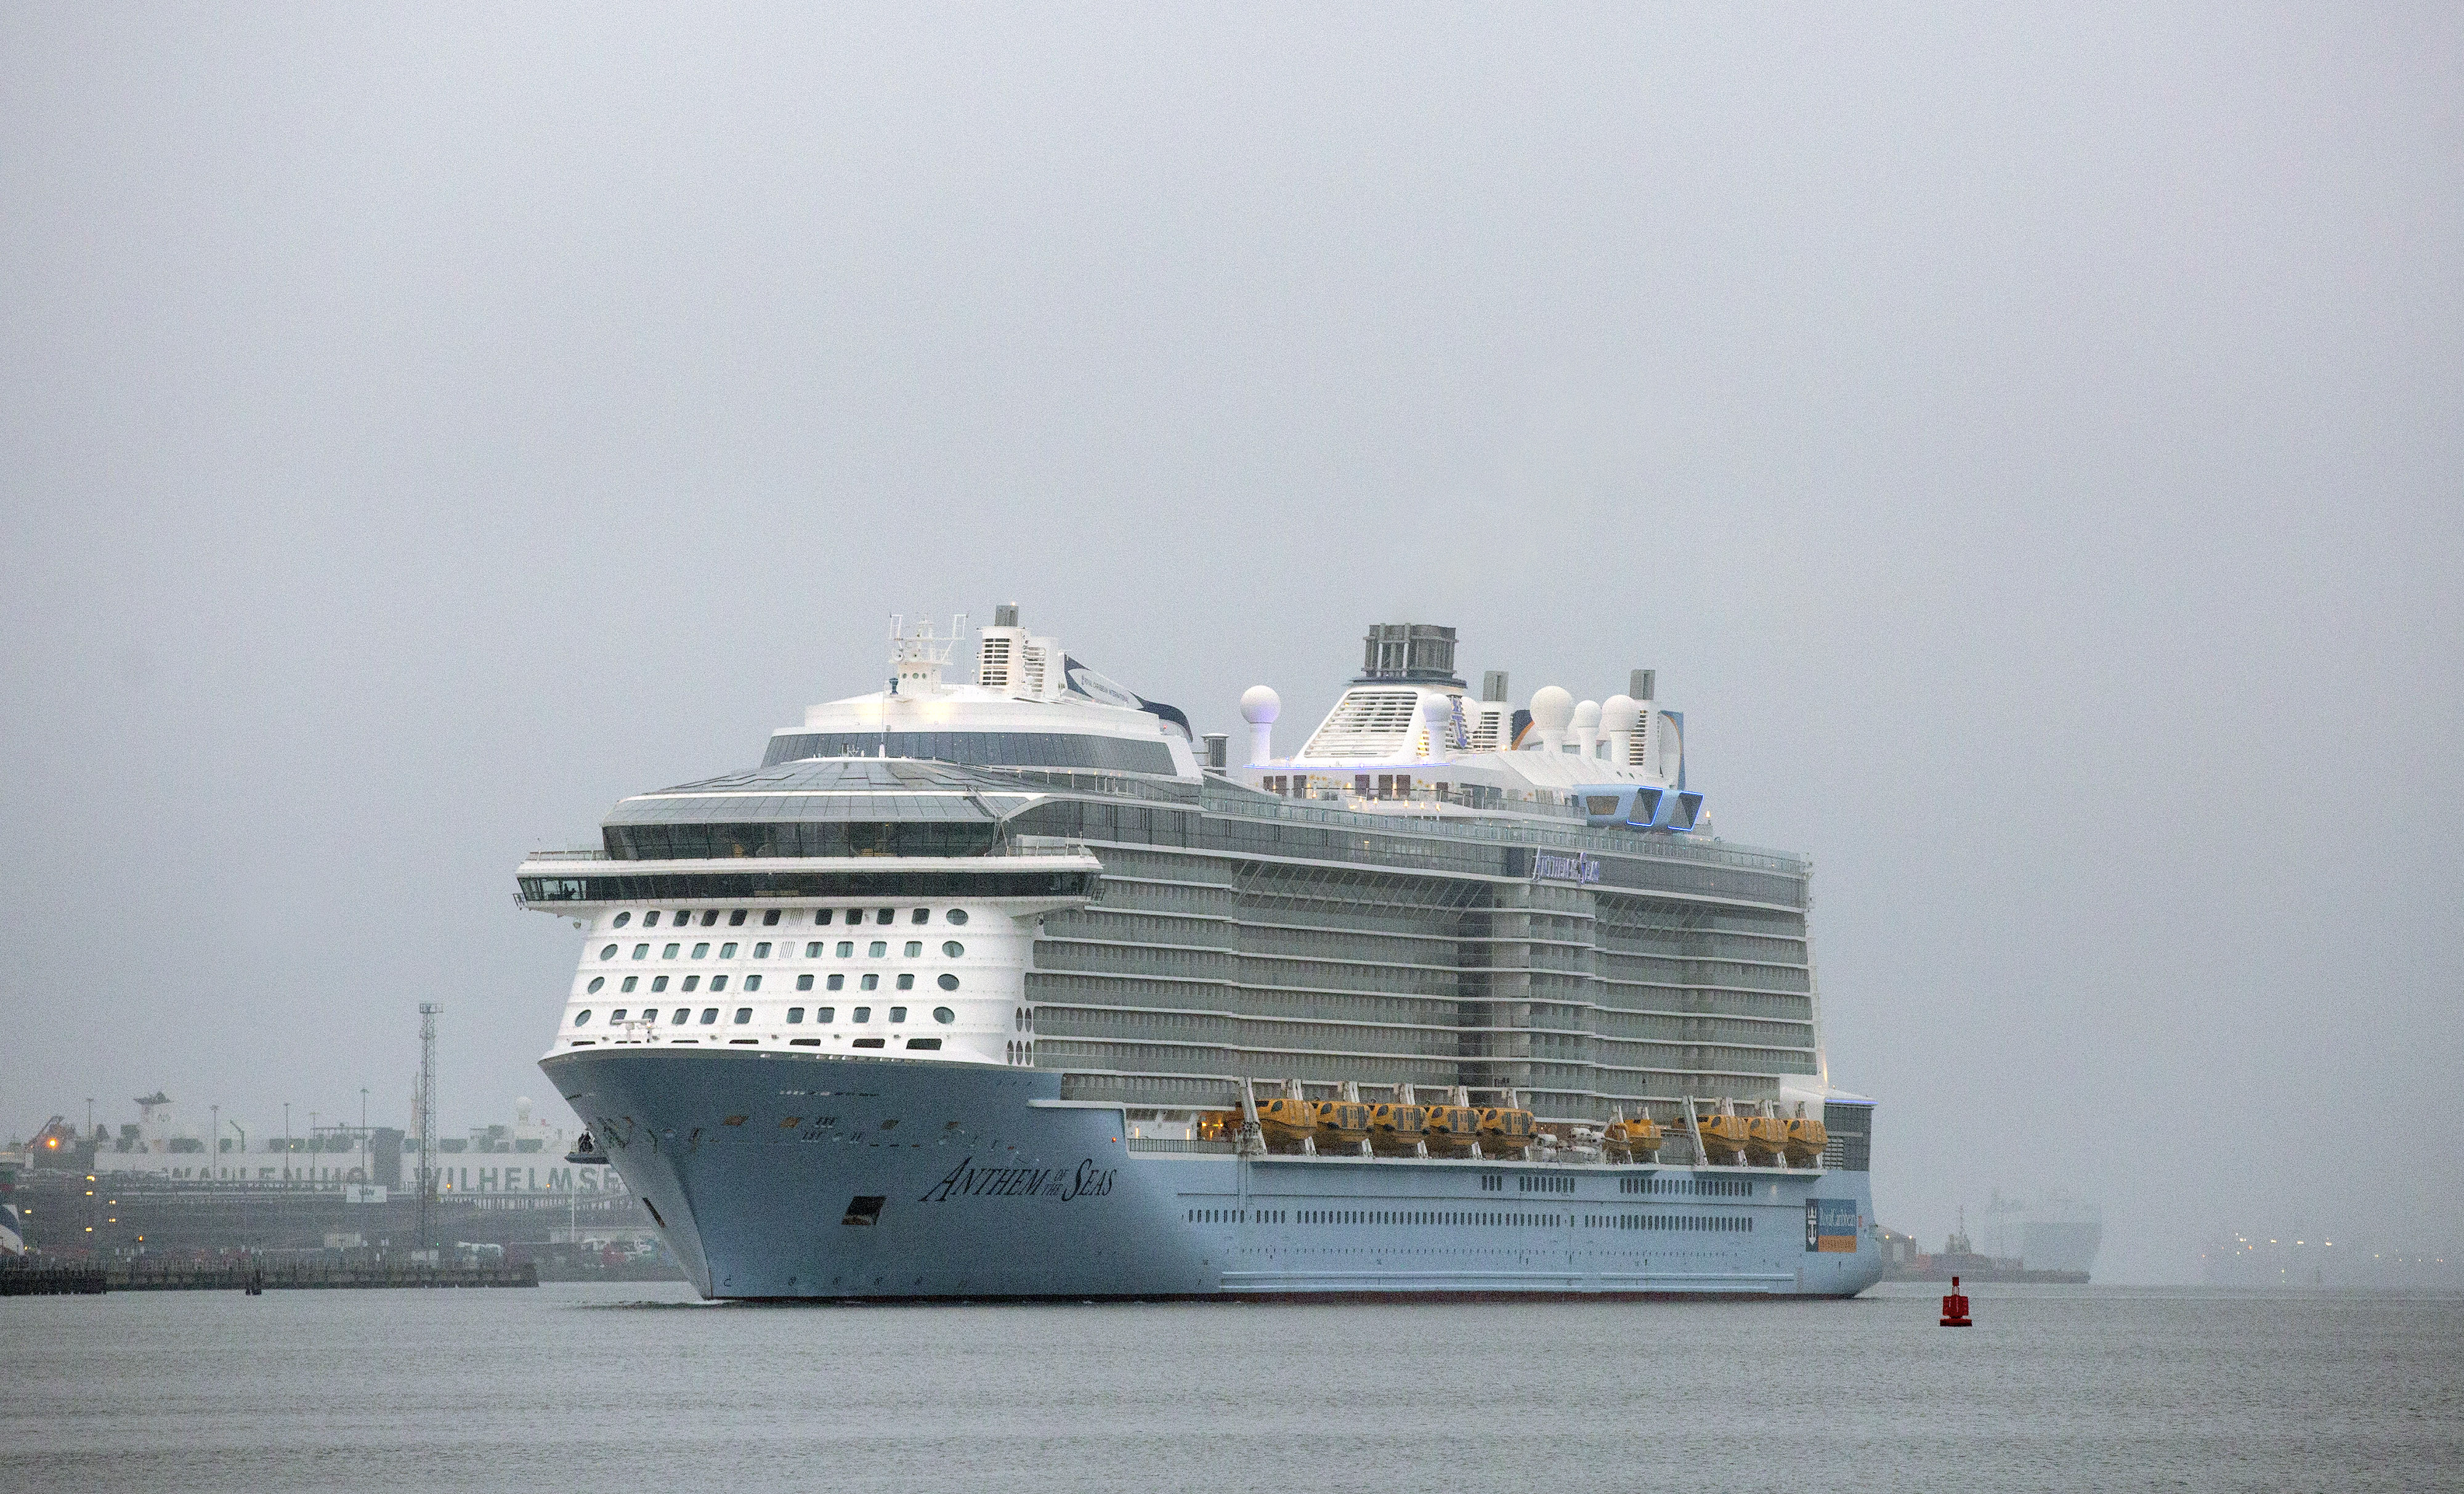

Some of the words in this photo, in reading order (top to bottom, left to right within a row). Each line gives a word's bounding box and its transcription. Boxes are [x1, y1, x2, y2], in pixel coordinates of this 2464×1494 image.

[917, 1156, 1051, 1202] ANTHEM
[1040, 1183, 1062, 1197] THE
[1054, 1169, 1069, 1182] OF
[1061, 1158, 1118, 1202] SEAS
